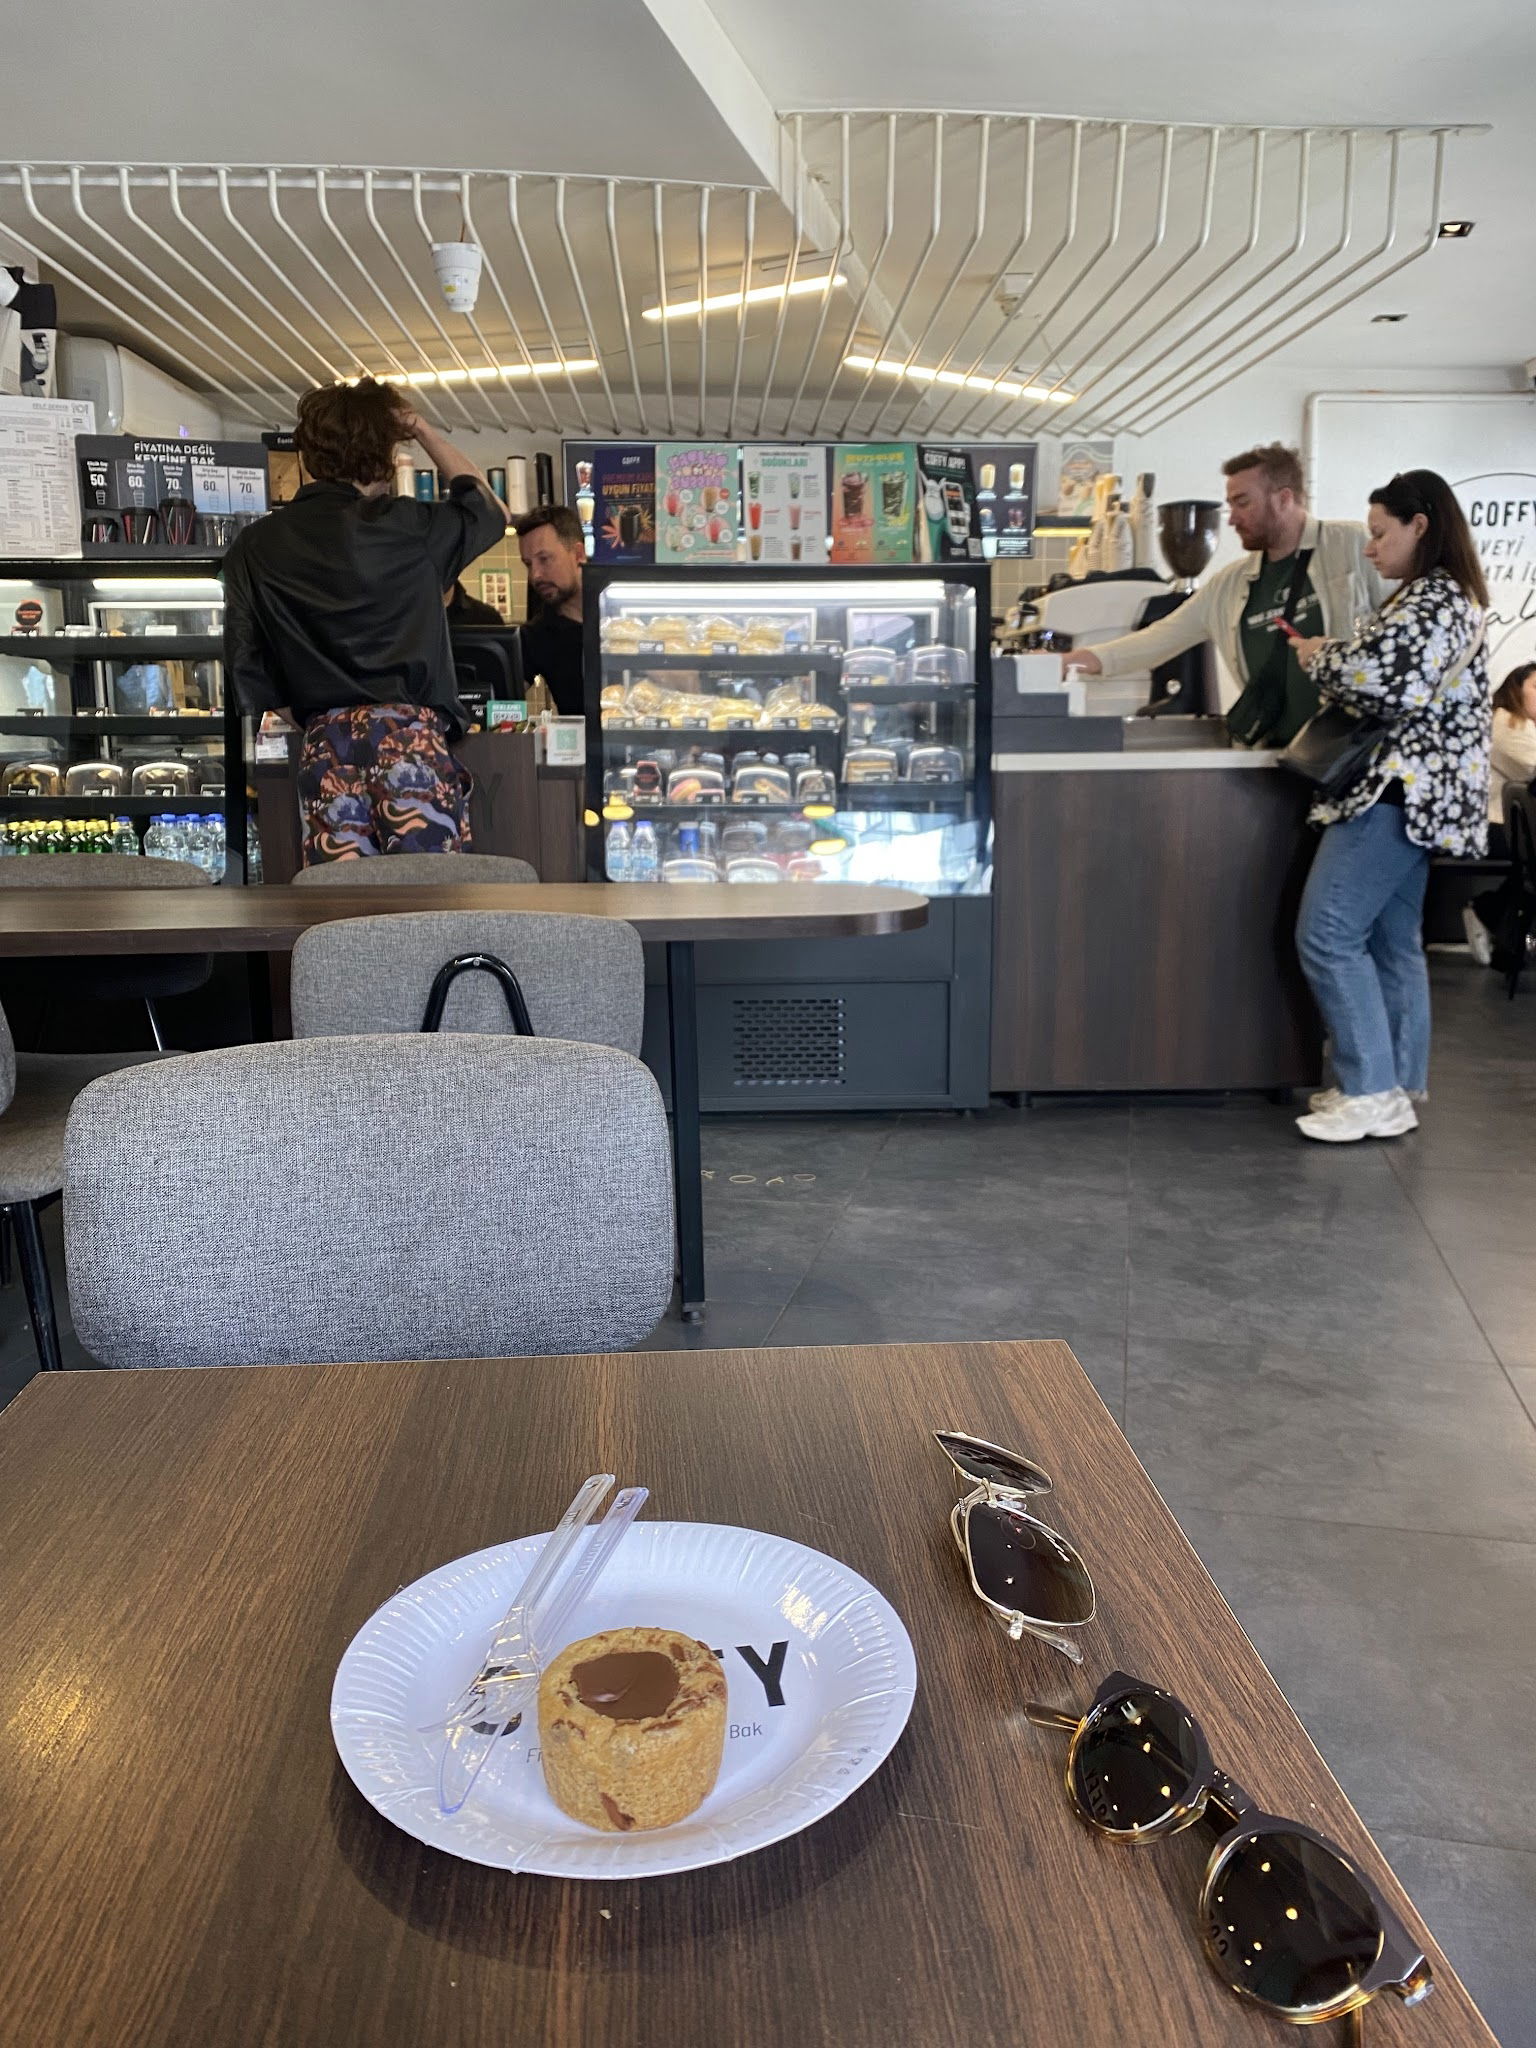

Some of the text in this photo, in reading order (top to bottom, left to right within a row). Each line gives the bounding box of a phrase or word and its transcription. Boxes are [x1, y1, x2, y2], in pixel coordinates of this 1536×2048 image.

[134, 441, 215, 456] FİYATINA DEĞİL
[190, 456, 215, 466] BAK
[90, 474, 105, 487] 50
[128, 476, 143, 488] 60
[165, 478, 180, 490] 70
[203, 480, 216, 491] 60
[240, 482, 252, 494] 70
[1471, 501, 1536, 527] COFF
[1481, 535, 1526, 556] VEYİ
[729, 1721, 763, 1740] Bak
